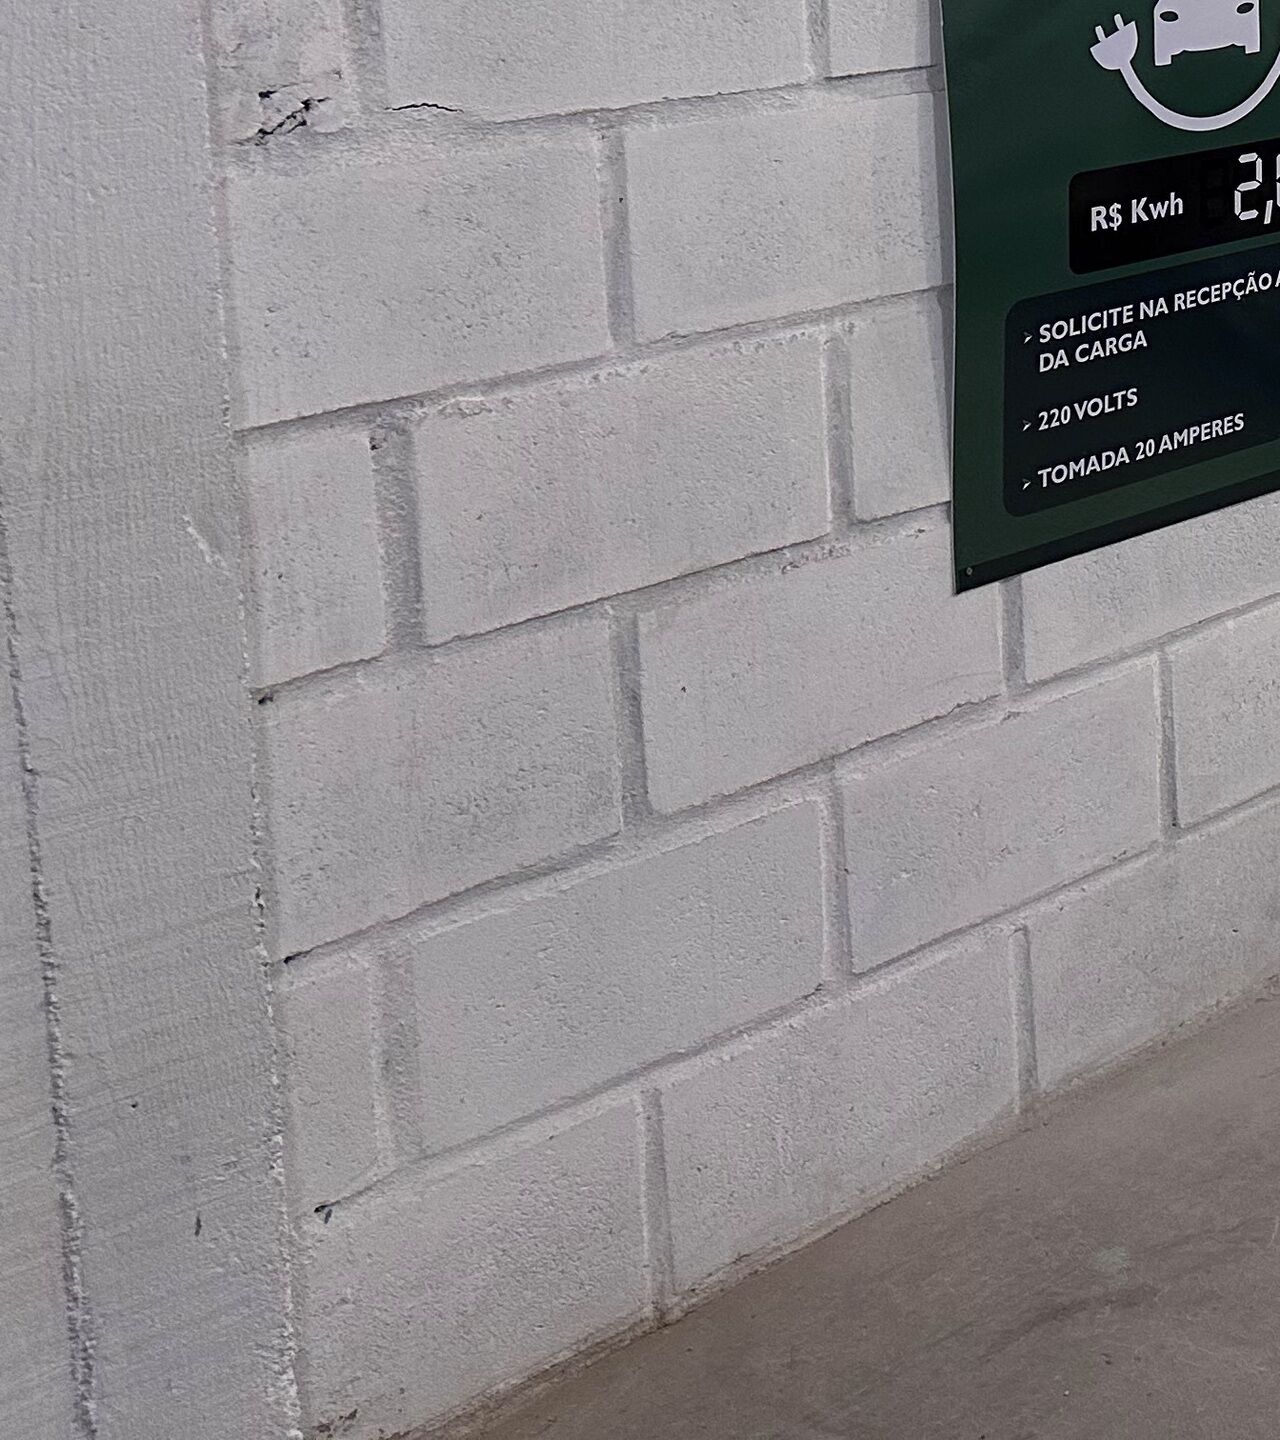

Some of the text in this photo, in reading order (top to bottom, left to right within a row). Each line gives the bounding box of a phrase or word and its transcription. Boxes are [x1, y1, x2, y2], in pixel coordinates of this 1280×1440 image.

[1090, 202, 1123, 233] R$
[1130, 191, 1184, 226] Kwh
[1038, 304, 1134, 344] SOLICITE
[1138, 297, 1169, 321] NA
[1173, 271, 1273, 311] RECEPÇÃO
[1038, 329, 1148, 373] DA CARGA
[1037, 387, 1139, 431] 220 VOLTS
[1037, 412, 1246, 489] TOMADA 20 AMPERES
